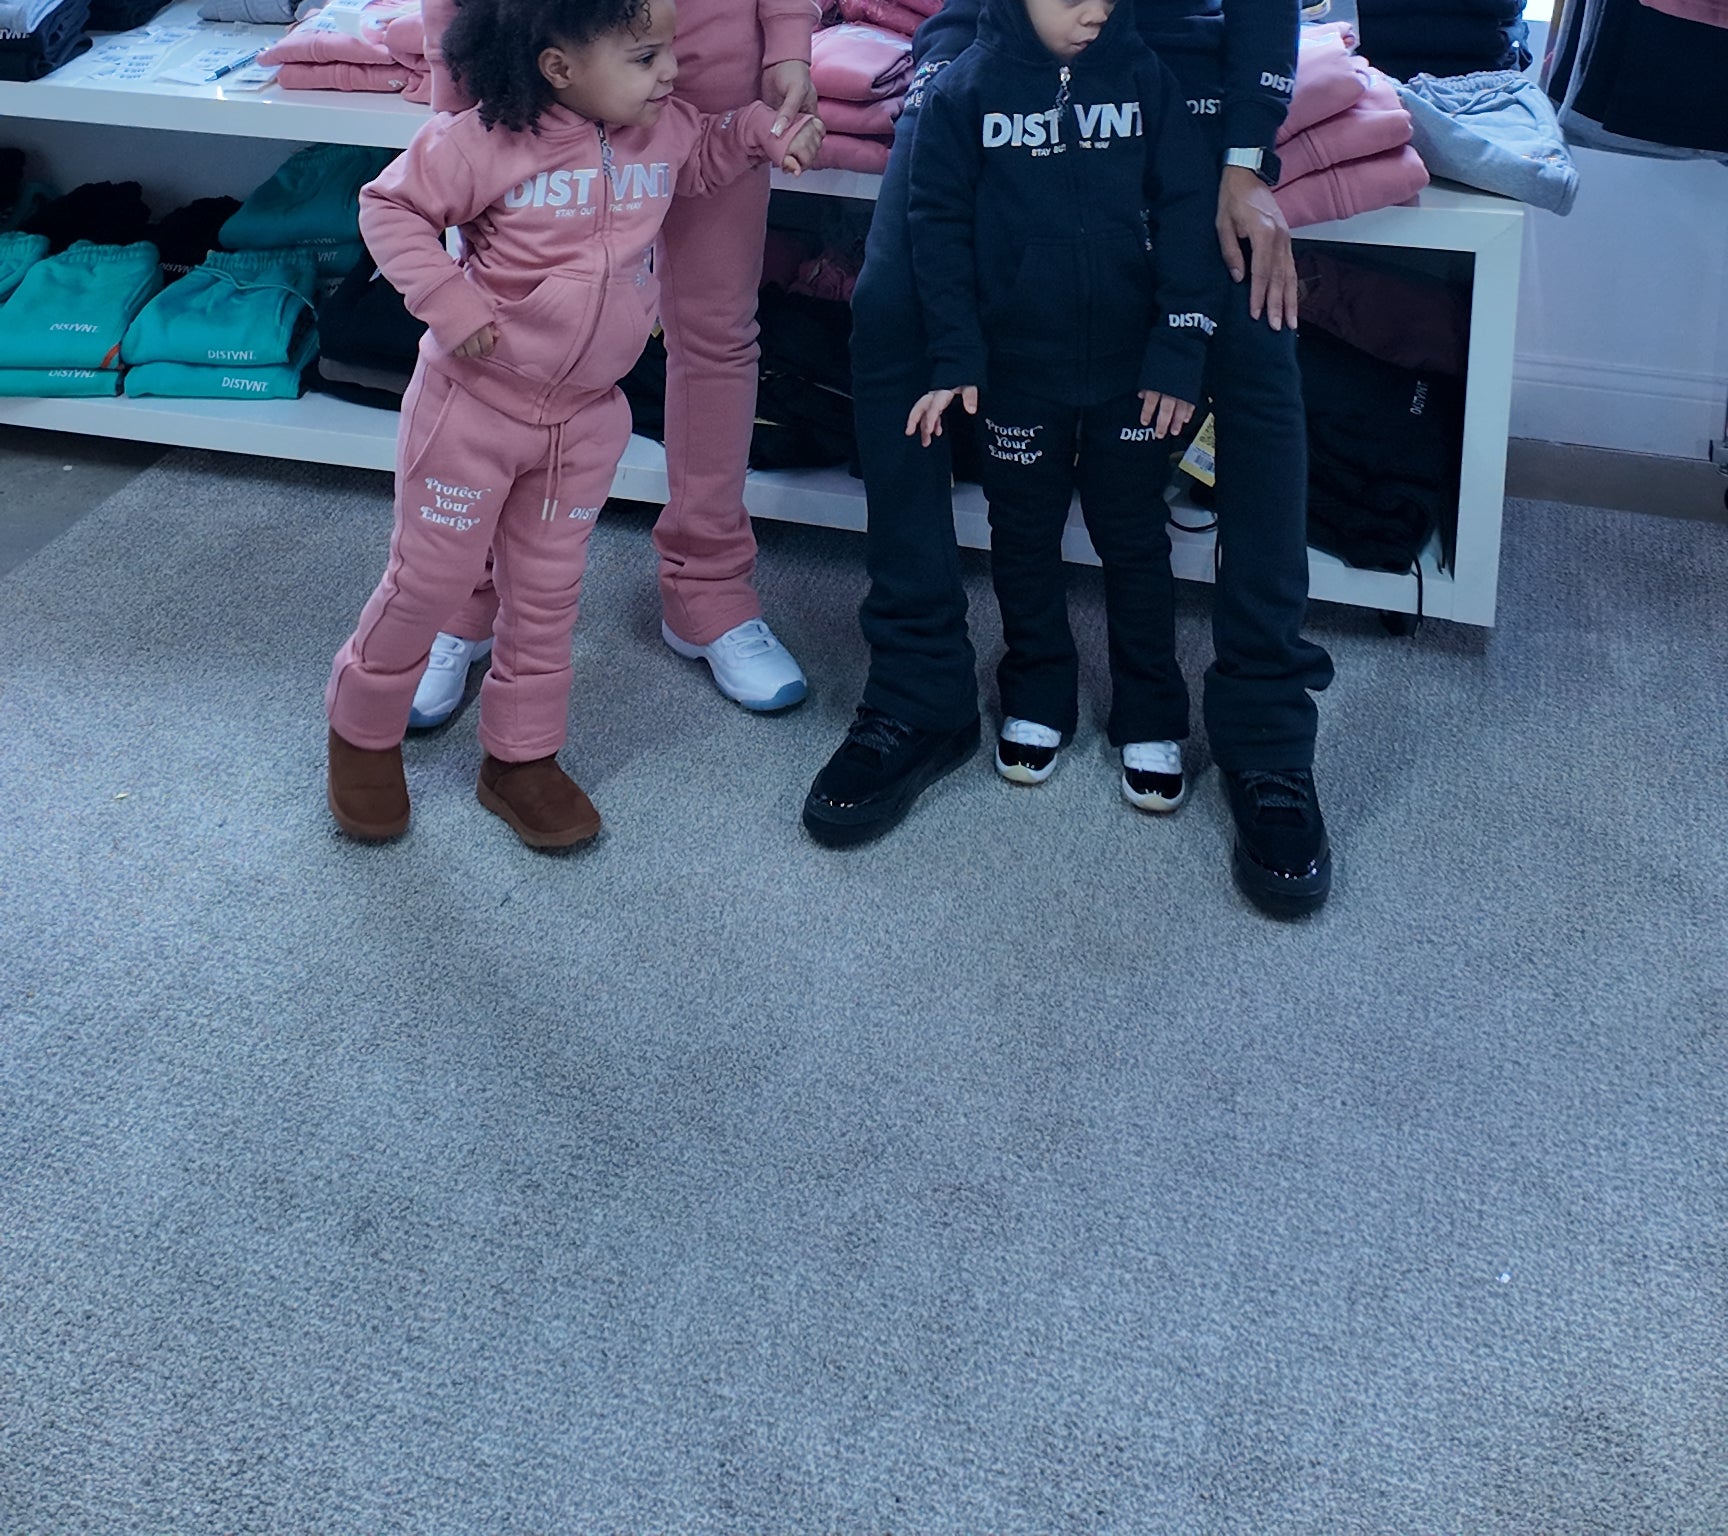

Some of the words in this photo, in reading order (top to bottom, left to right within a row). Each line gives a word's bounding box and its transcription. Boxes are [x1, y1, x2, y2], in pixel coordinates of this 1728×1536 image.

[1031, 148, 1051, 157] STAY
[555, 209, 576, 218] STAY
[580, 207, 597, 216] OUT
[609, 204, 623, 212] THE
[626, 202, 642, 211] WAY
[317, 251, 338, 263] VNT
[208, 350, 255, 361] DISTVNT
[222, 376, 268, 392] DISTVNT
[985, 418, 1043, 438] Protect
[1120, 427, 1157, 441] DISTV
[996, 435, 1031, 450] Your
[988, 444, 1043, 465] Energy
[424, 477, 491, 500] Protect
[435, 495, 475, 513] Your
[420, 505, 480, 531] Energy
